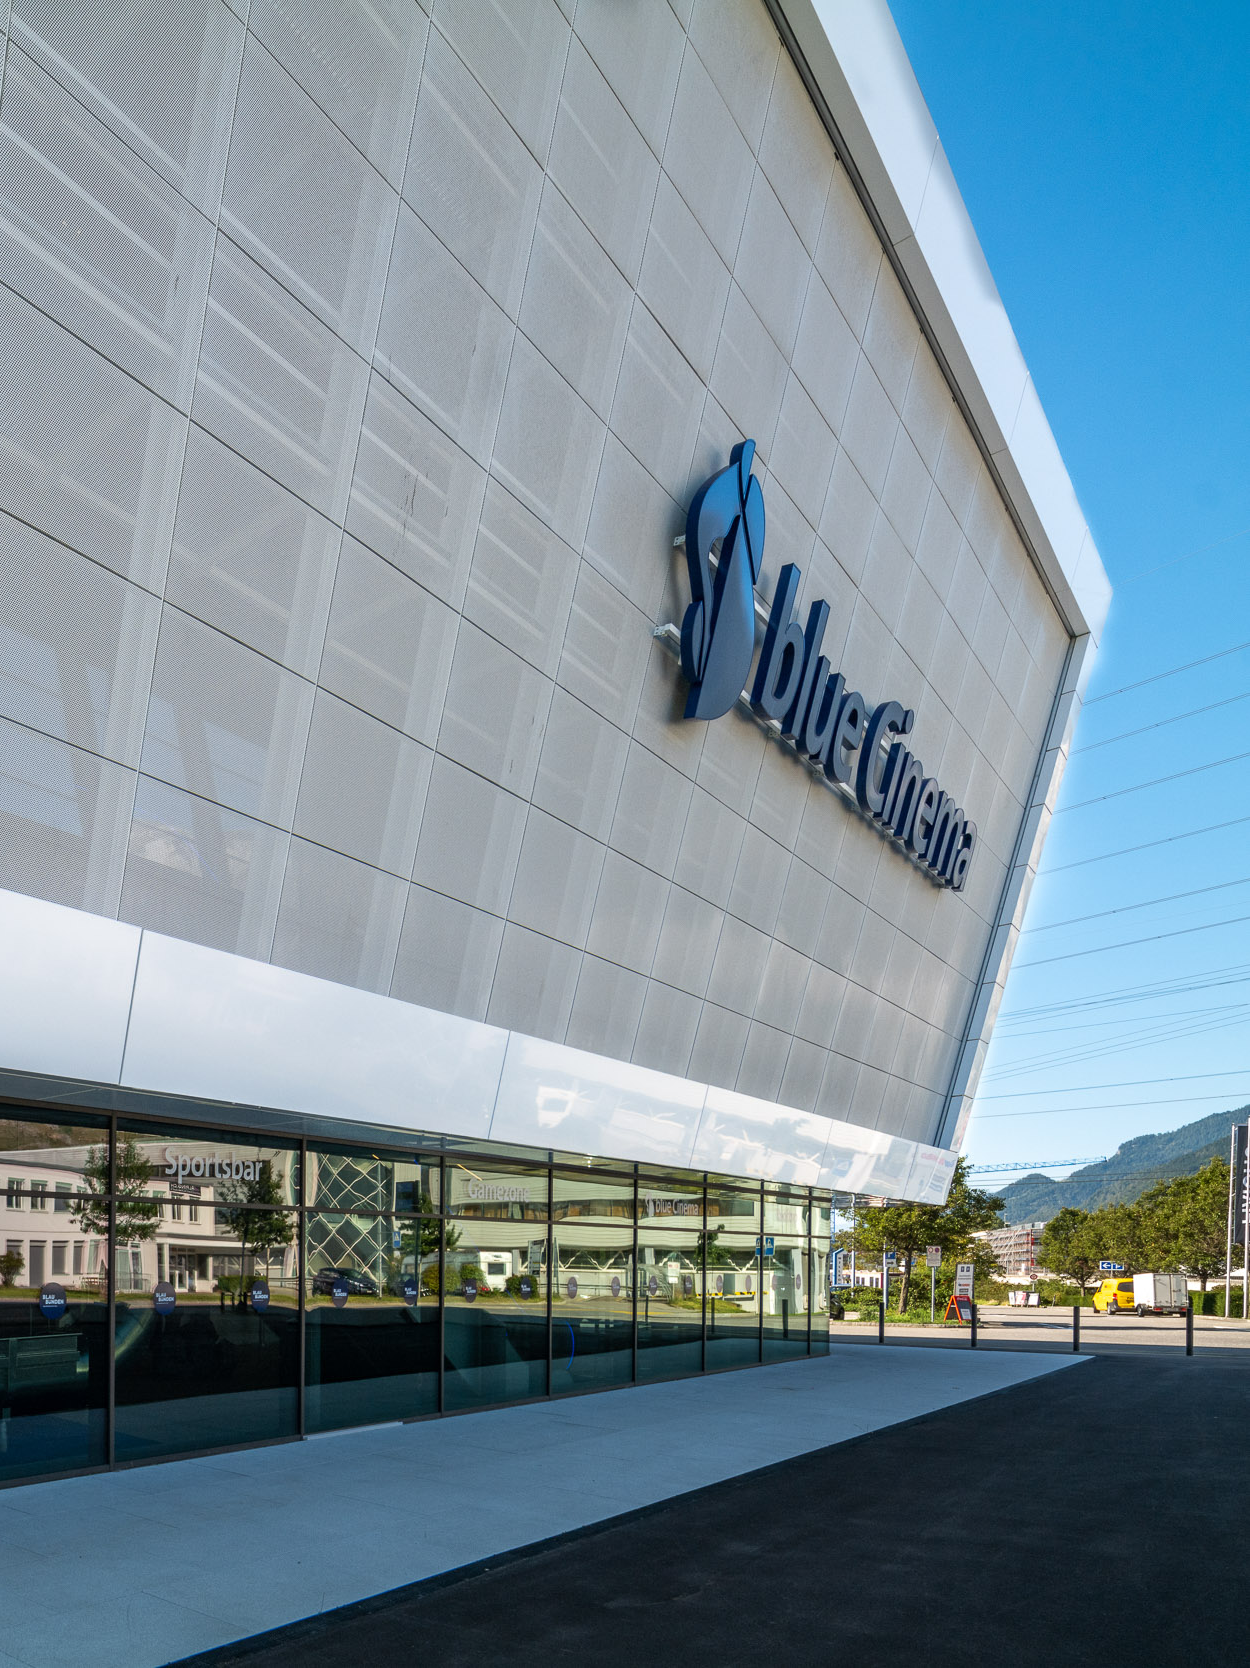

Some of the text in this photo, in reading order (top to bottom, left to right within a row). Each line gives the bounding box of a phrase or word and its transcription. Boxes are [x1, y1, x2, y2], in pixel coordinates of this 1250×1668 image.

[751, 562, 978, 893] blue Cinema
[165, 1146, 263, 1185] Sportsbar
[468, 1176, 530, 1203] Gamezone
[655, 1197, 700, 1217] blue Cinema
